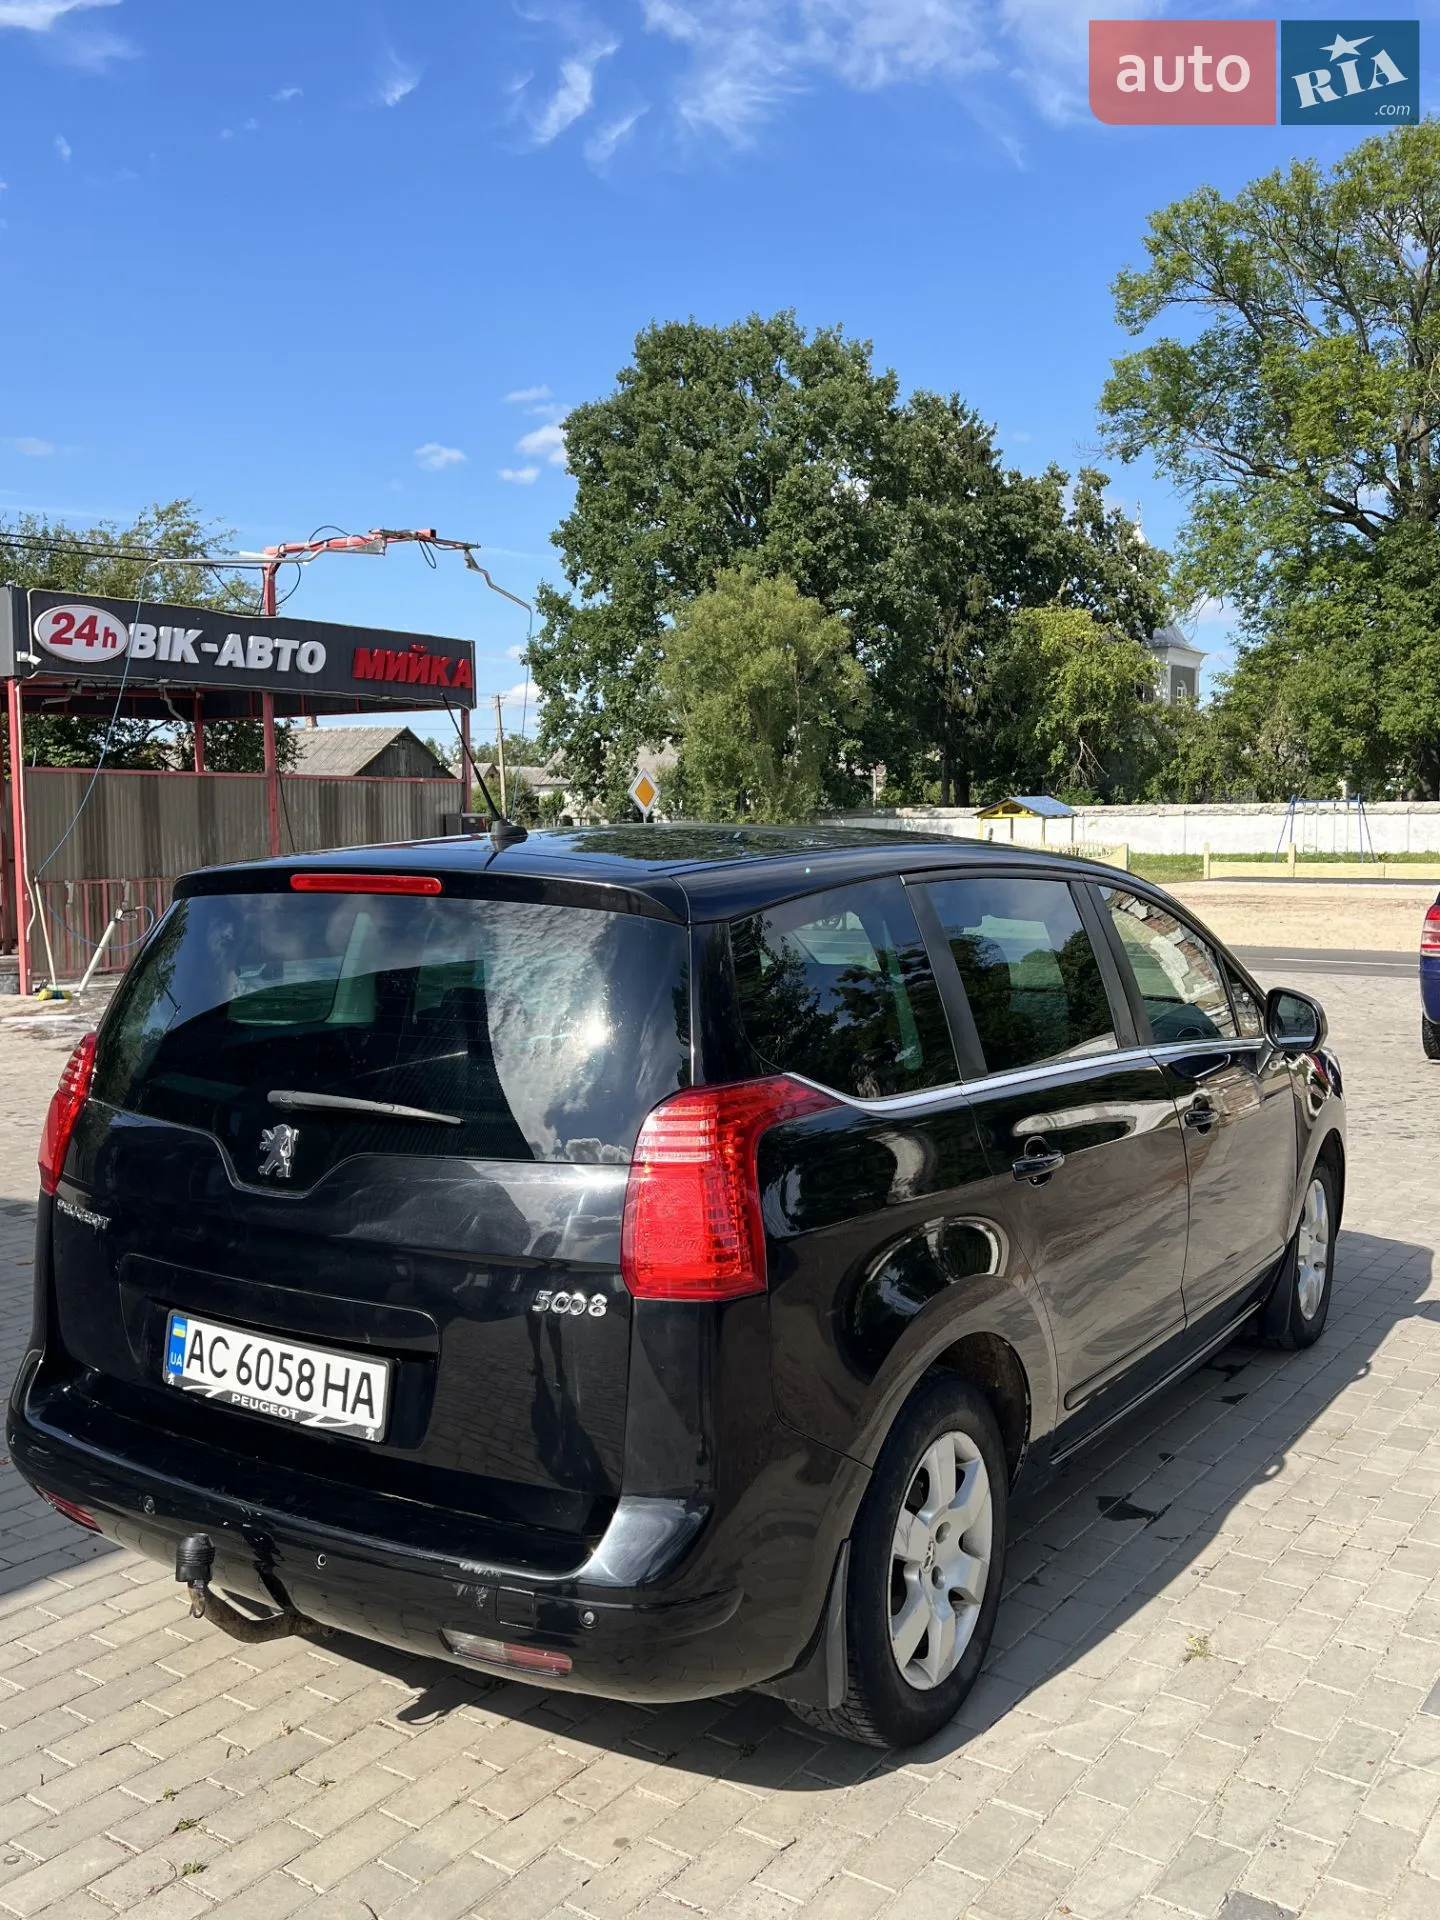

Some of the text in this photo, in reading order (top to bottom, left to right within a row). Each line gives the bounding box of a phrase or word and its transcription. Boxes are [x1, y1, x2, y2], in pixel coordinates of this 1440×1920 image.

[49, 612, 118, 649] 24h
[128, 622, 473, 689] ВІК-АВТО МИЙКА
[532, 1290, 607, 1317] 5008
[170, 1351, 182, 1368] UA
[186, 1329, 375, 1419] AC 6058 HA
[231, 1393, 299, 1421] PEUGEOT
